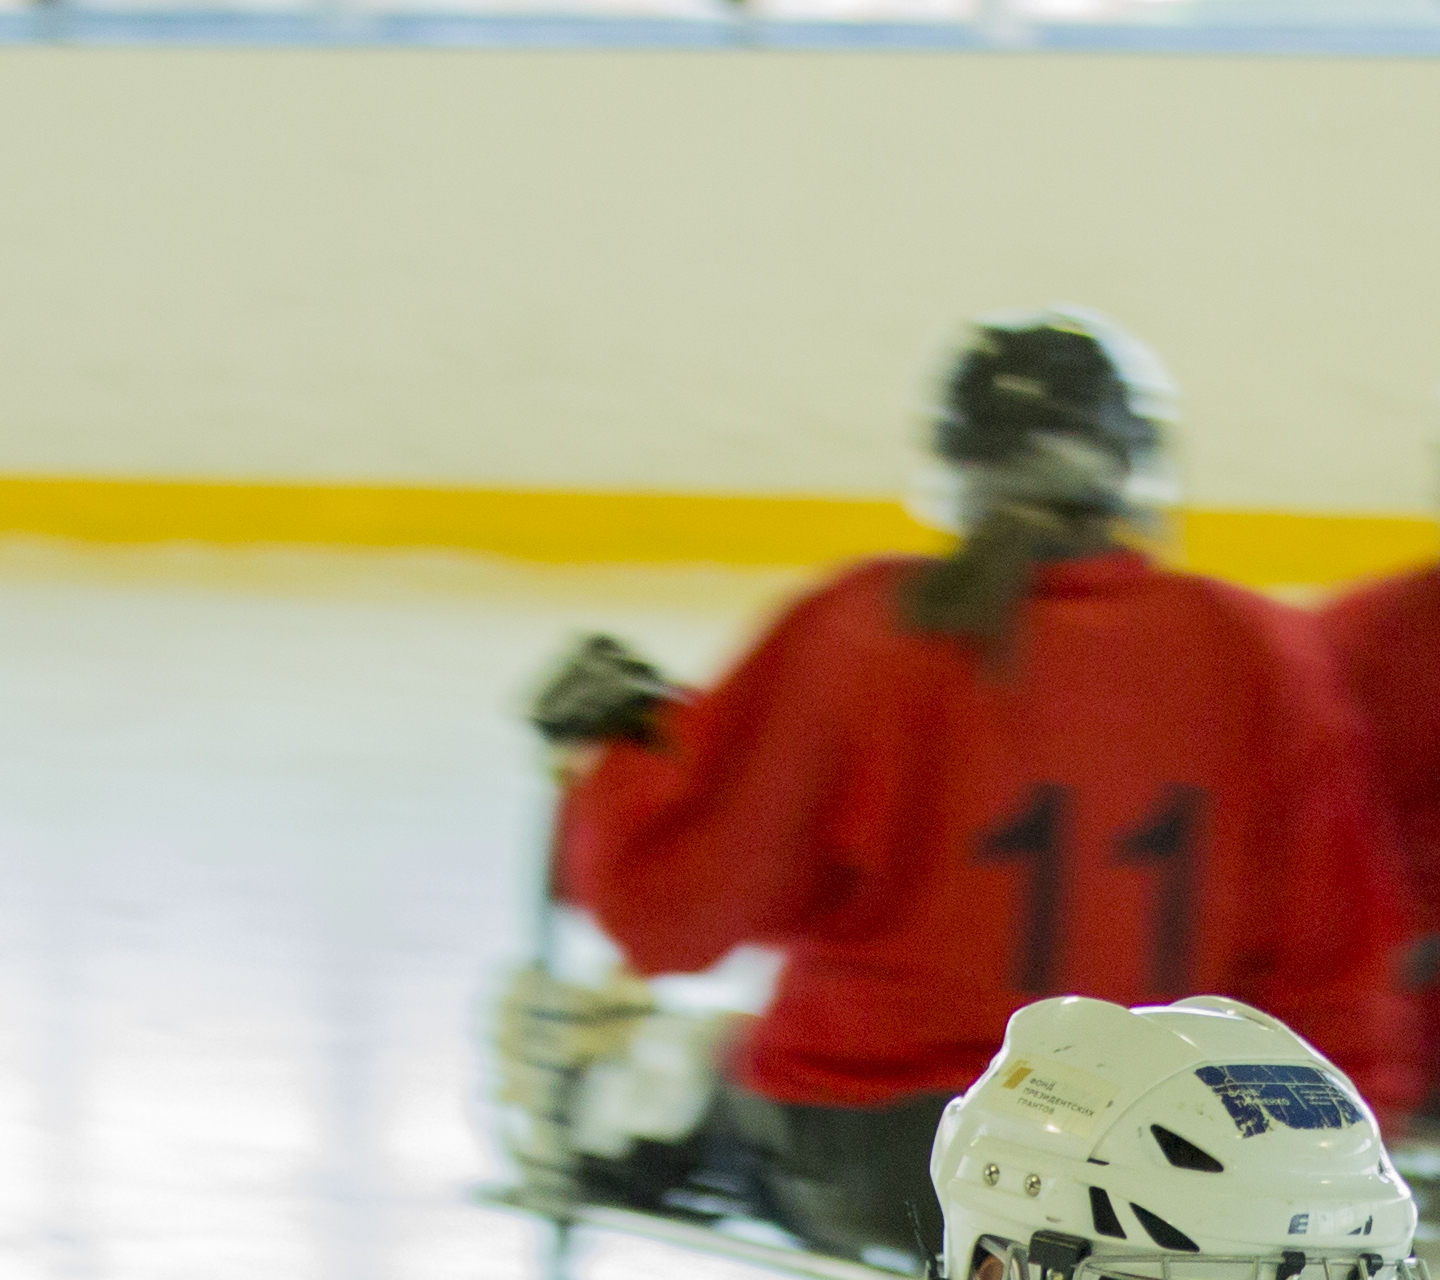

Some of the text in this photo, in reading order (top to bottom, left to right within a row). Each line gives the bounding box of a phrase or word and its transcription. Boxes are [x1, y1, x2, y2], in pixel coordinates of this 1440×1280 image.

[966, 781, 1214, 995] 11
[1029, 1078, 1055, 1091] ФОНД
[1017, 1097, 1055, 1115] ГРАНТОВ
[1023, 1087, 1095, 1117] ПРЕЗИДЕНТСКИХ
